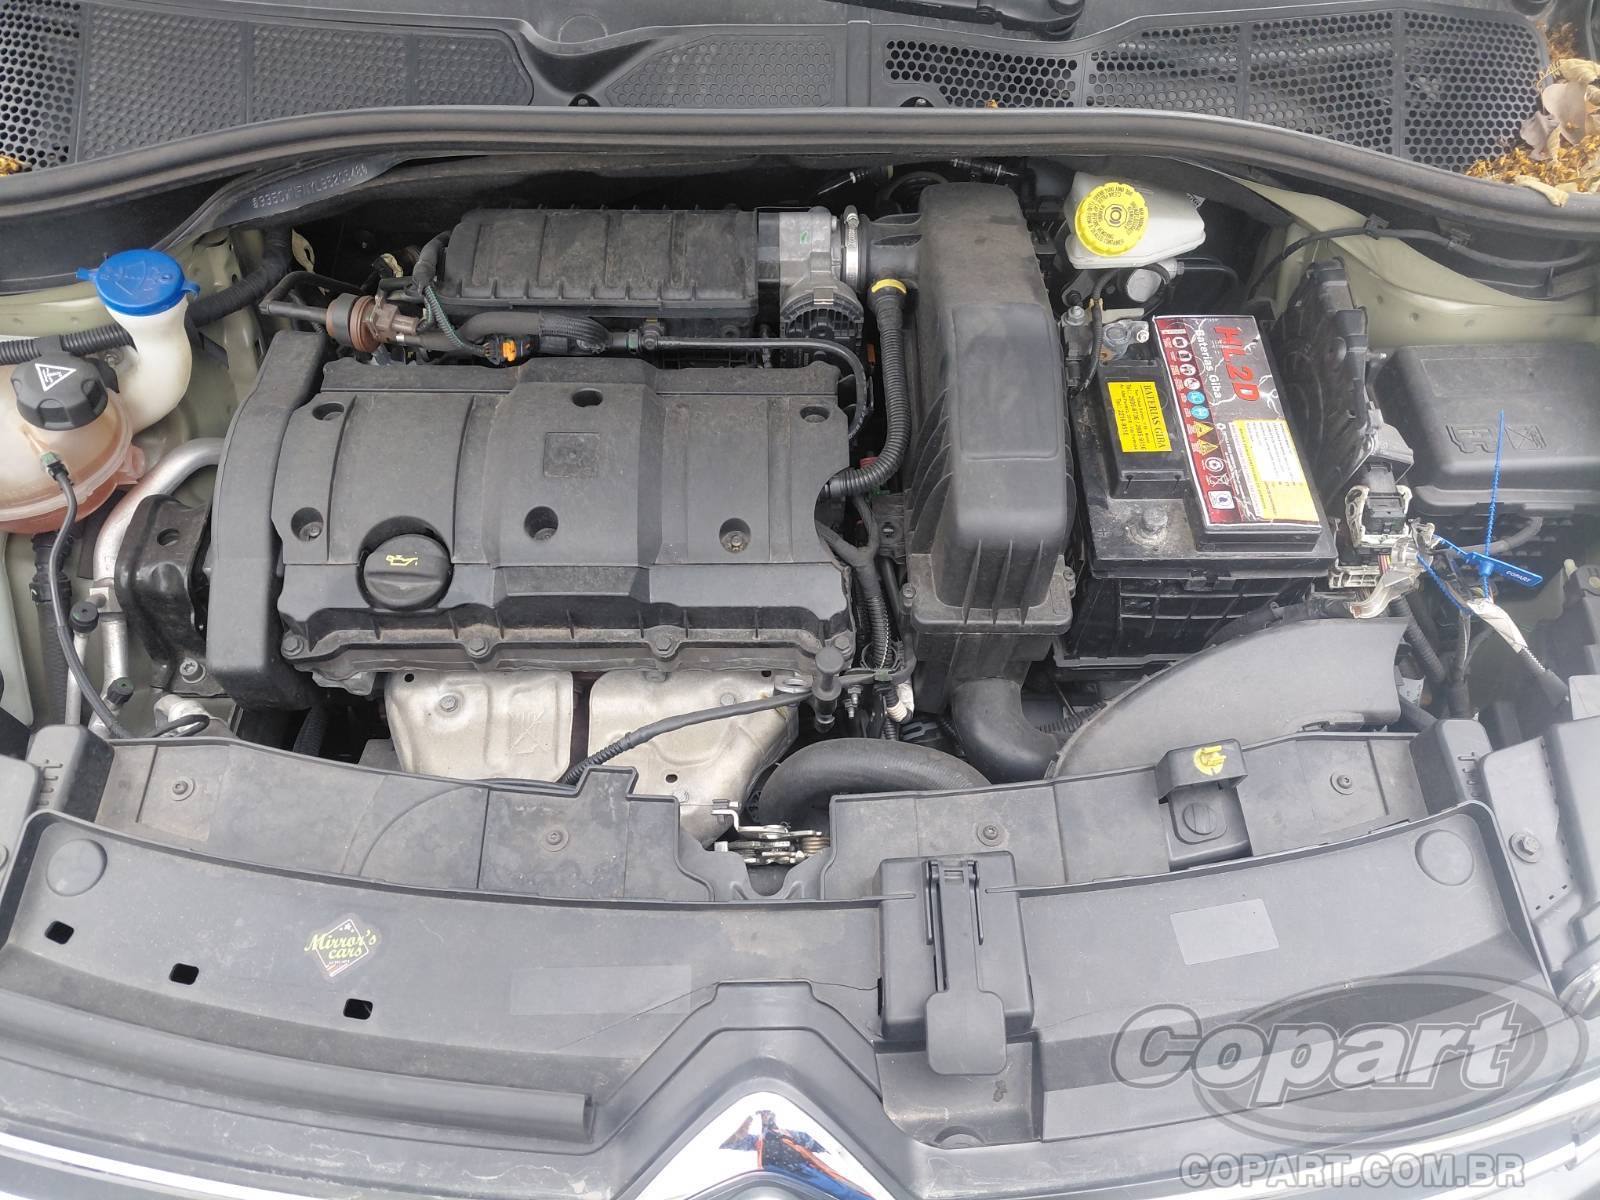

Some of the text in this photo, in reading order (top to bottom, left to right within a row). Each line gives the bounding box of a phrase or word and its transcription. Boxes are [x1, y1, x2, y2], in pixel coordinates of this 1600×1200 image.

[1193, 329, 1223, 400] Baterias Giba
[1214, 326, 1260, 402] HL2D
[1143, 384, 1167, 449] BATERIAS GIBA
[304, 929, 377, 952] Mirror's
[328, 947, 362, 960] cars
